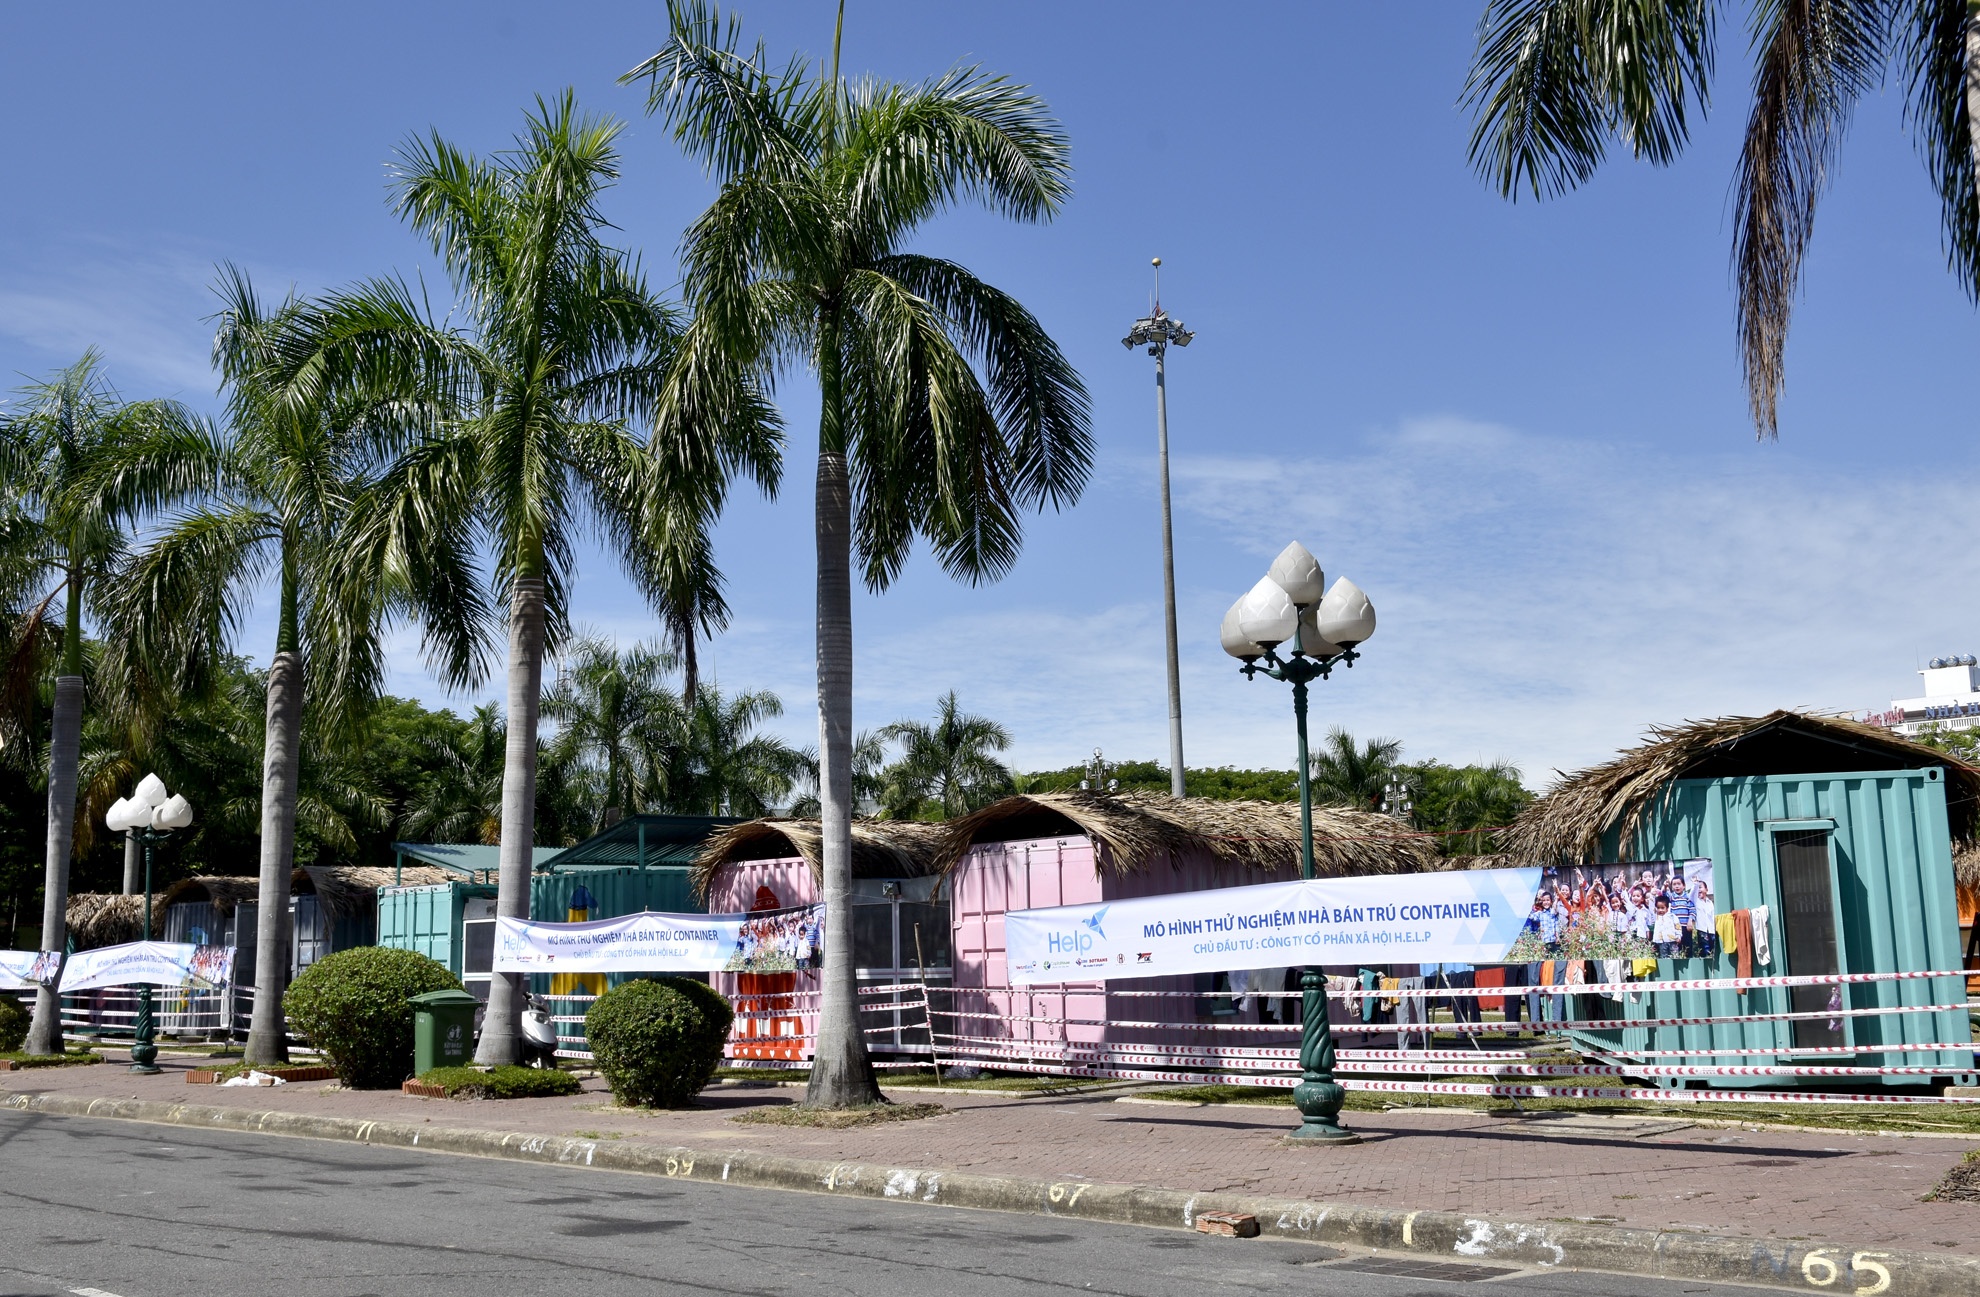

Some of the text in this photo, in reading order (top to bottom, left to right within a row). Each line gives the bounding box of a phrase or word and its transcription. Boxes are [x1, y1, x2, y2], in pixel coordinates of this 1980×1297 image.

[1925, 699, 1964, 718] NHÀ
[1143, 902, 1491, 938] MÔ HÌNH THỬ NGHIỆM NHÀ BÁN TRÚ CONTAINER
[503, 934, 527, 951] Help
[592, 931, 621, 946] NGHIỆM
[622, 930, 637, 942] NHÀ
[638, 929, 655, 941] BÁN
[655, 928, 672, 941] TRÚ
[673, 929, 719, 941] CONTAINER
[1048, 930, 1093, 956] Help
[1193, 939, 1215, 954] CHỦ
[1239, 938, 1254, 950] TƯ
[1261, 935, 1291, 949] CÔNG
[1292, 935, 1303, 946] TY
[1304, 931, 1321, 945] CỔ
[1355, 930, 1370, 944] XÃ
[1372, 930, 1392, 946] HỘI
[1394, 931, 1432, 943] H.E.L.P
[1802, 1248, 1892, 1297] 65
